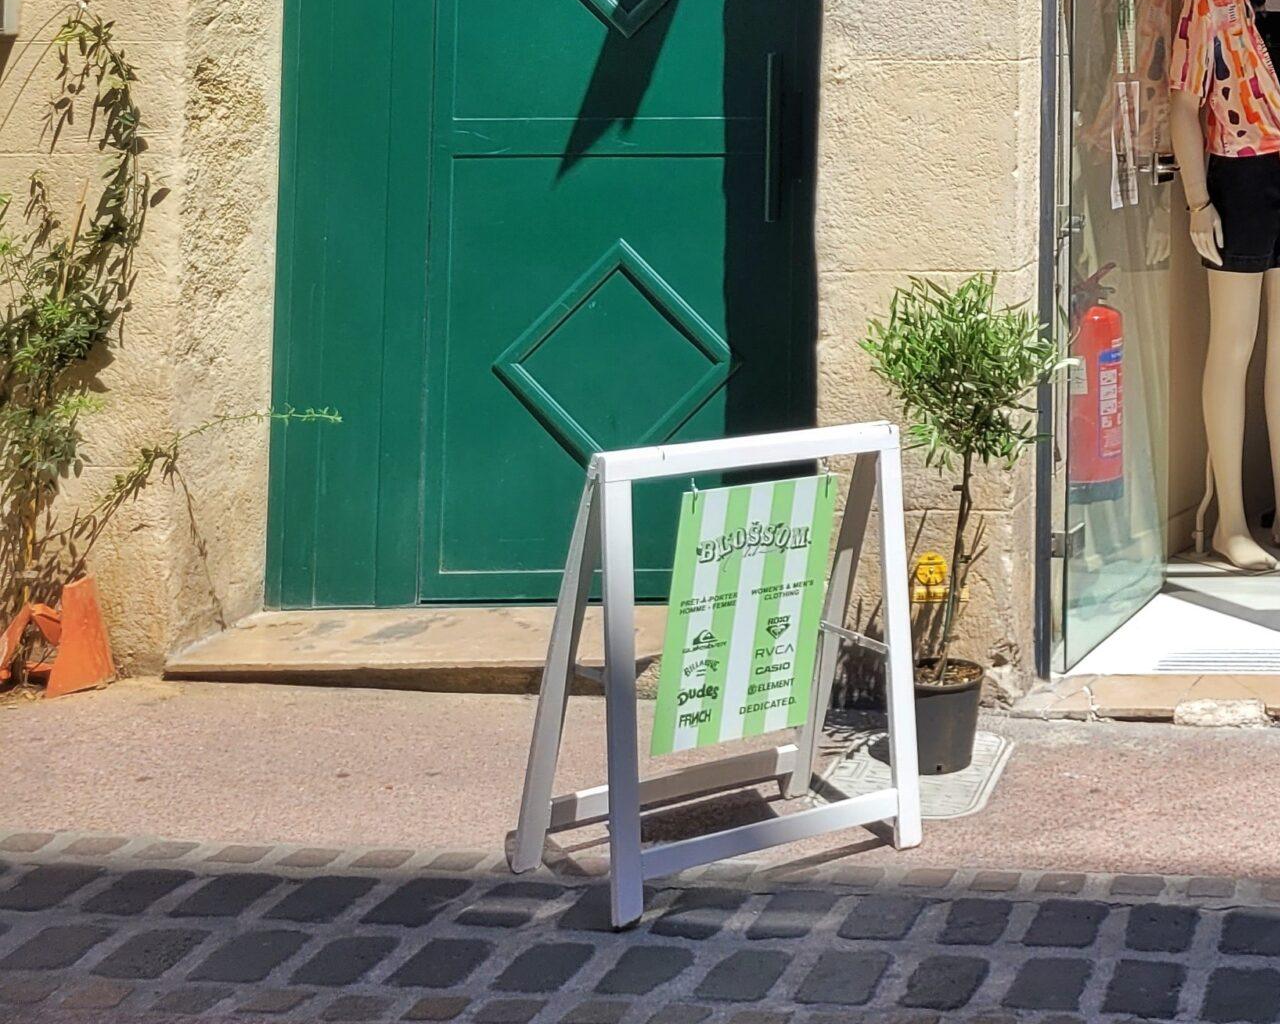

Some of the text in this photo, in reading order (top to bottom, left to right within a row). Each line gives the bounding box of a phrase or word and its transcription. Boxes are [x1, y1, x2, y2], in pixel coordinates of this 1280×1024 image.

[698, 524, 810, 564] BLOSSOM
[751, 583, 784, 596] WOMEN'S
[793, 579, 815, 588] MEN'S
[764, 589, 800, 601] CLOTHING
[679, 605, 706, 616] HOMME
[712, 599, 737, 611] FEMME
[767, 615, 792, 625] ROXY
[755, 644, 795, 660] RVCA
[755, 661, 791, 675] CASIO
[757, 678, 796, 692] ELEMENT
[677, 683, 720, 706] Dudes
[739, 696, 797, 715] DEDICATED.
